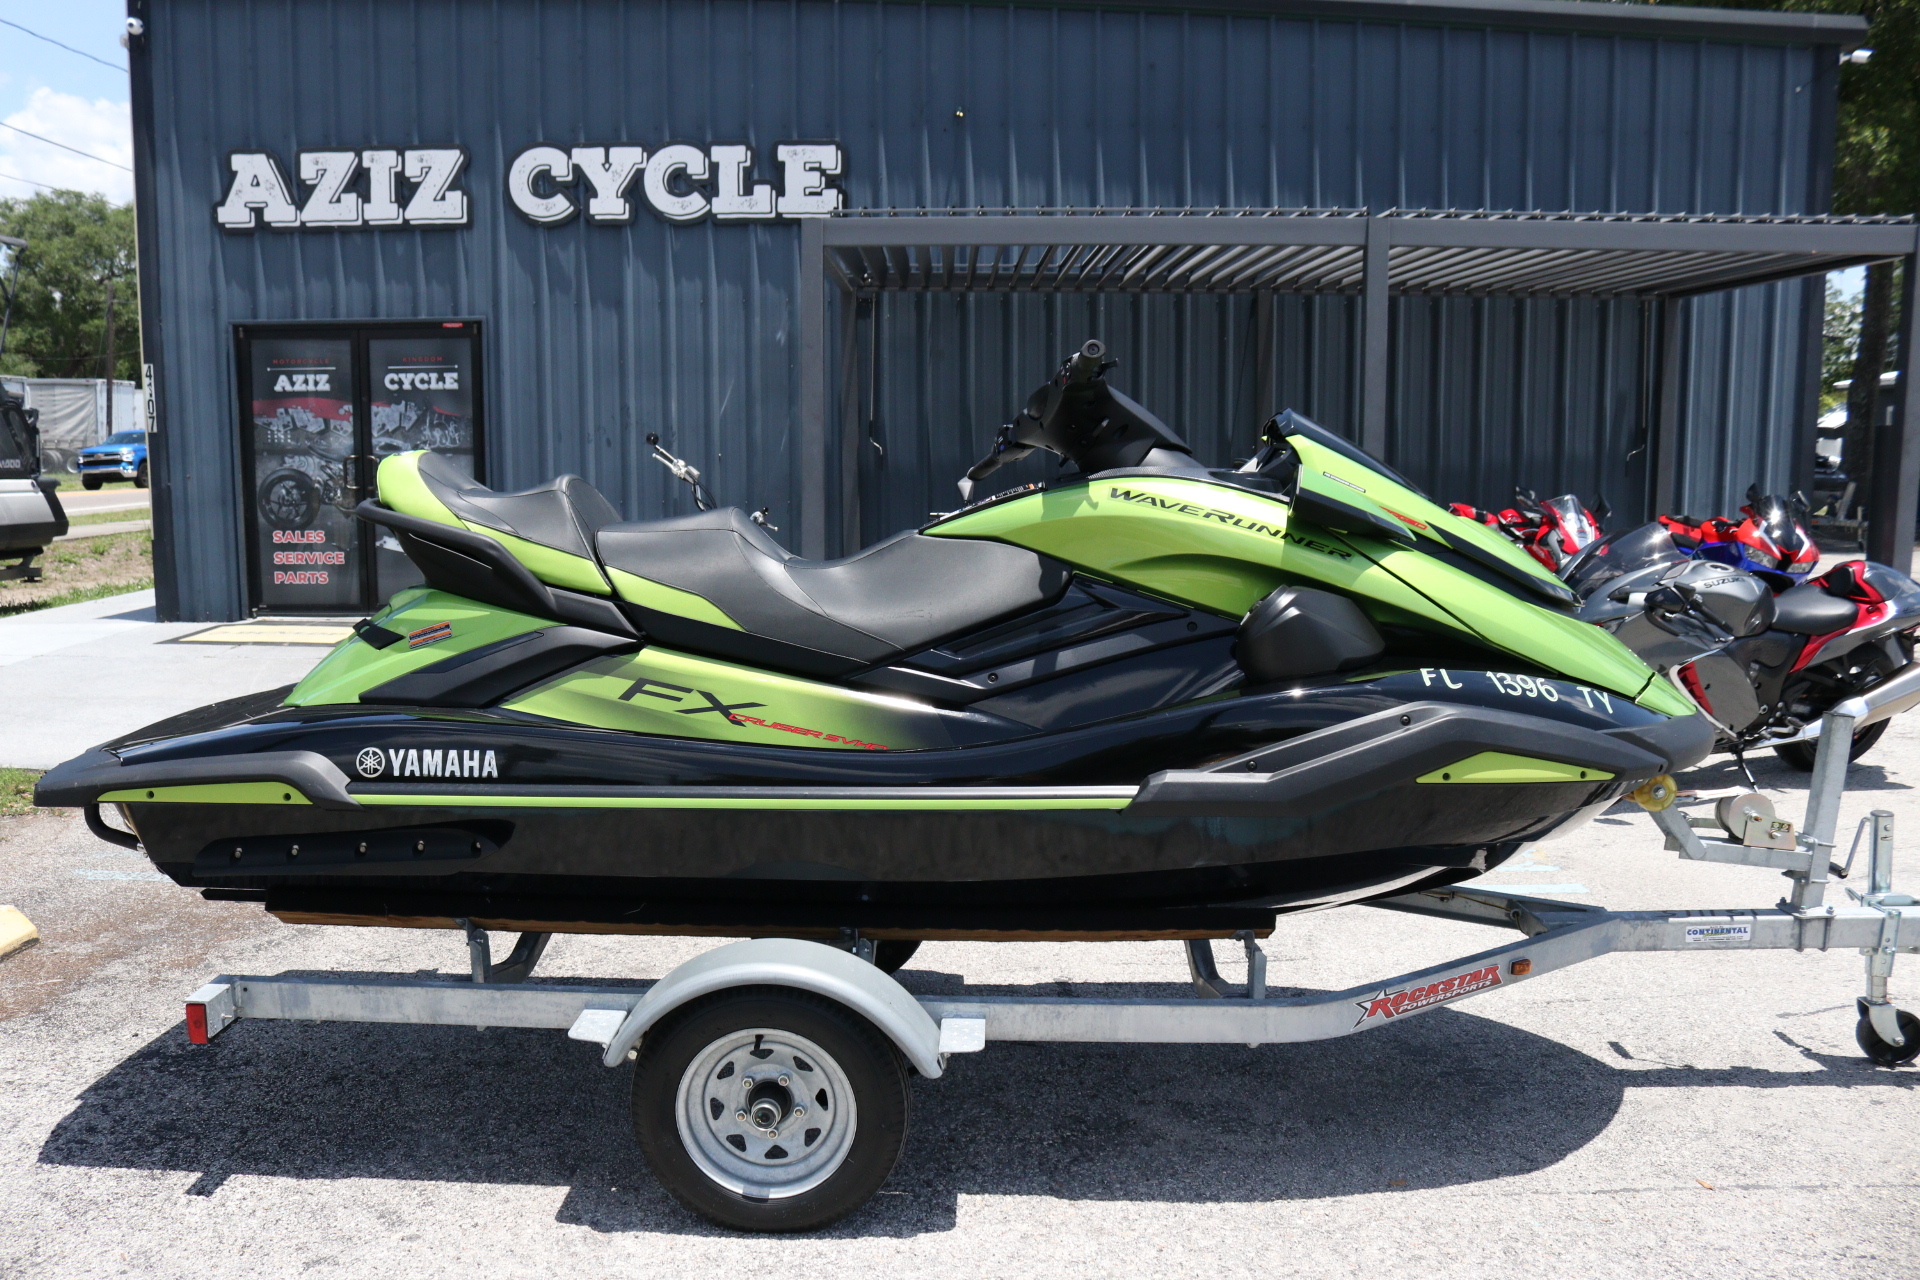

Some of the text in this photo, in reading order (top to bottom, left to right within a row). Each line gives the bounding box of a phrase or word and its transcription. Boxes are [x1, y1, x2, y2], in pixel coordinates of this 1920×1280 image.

[217, 144, 844, 228] AZIZ CYCLE
[273, 373, 331, 392] AZIZ
[384, 371, 459, 391] CYCLE
[272, 530, 326, 543] SALES
[273, 551, 345, 564] SERVICE
[274, 571, 329, 584] PARTS
[1703, 576, 1745, 588] SUZUKI
[618, 677, 768, 727] FX
[1420, 668, 1614, 714] FL 1396 TY
[728, 713, 823, 739] CRUISER
[388, 748, 498, 778] YAMAHA
[1687, 926, 1748, 936] CONTINENTAL
[1366, 964, 1499, 1019] ROCKSTAR
[1398, 979, 1493, 1013] POWERSPORTS
